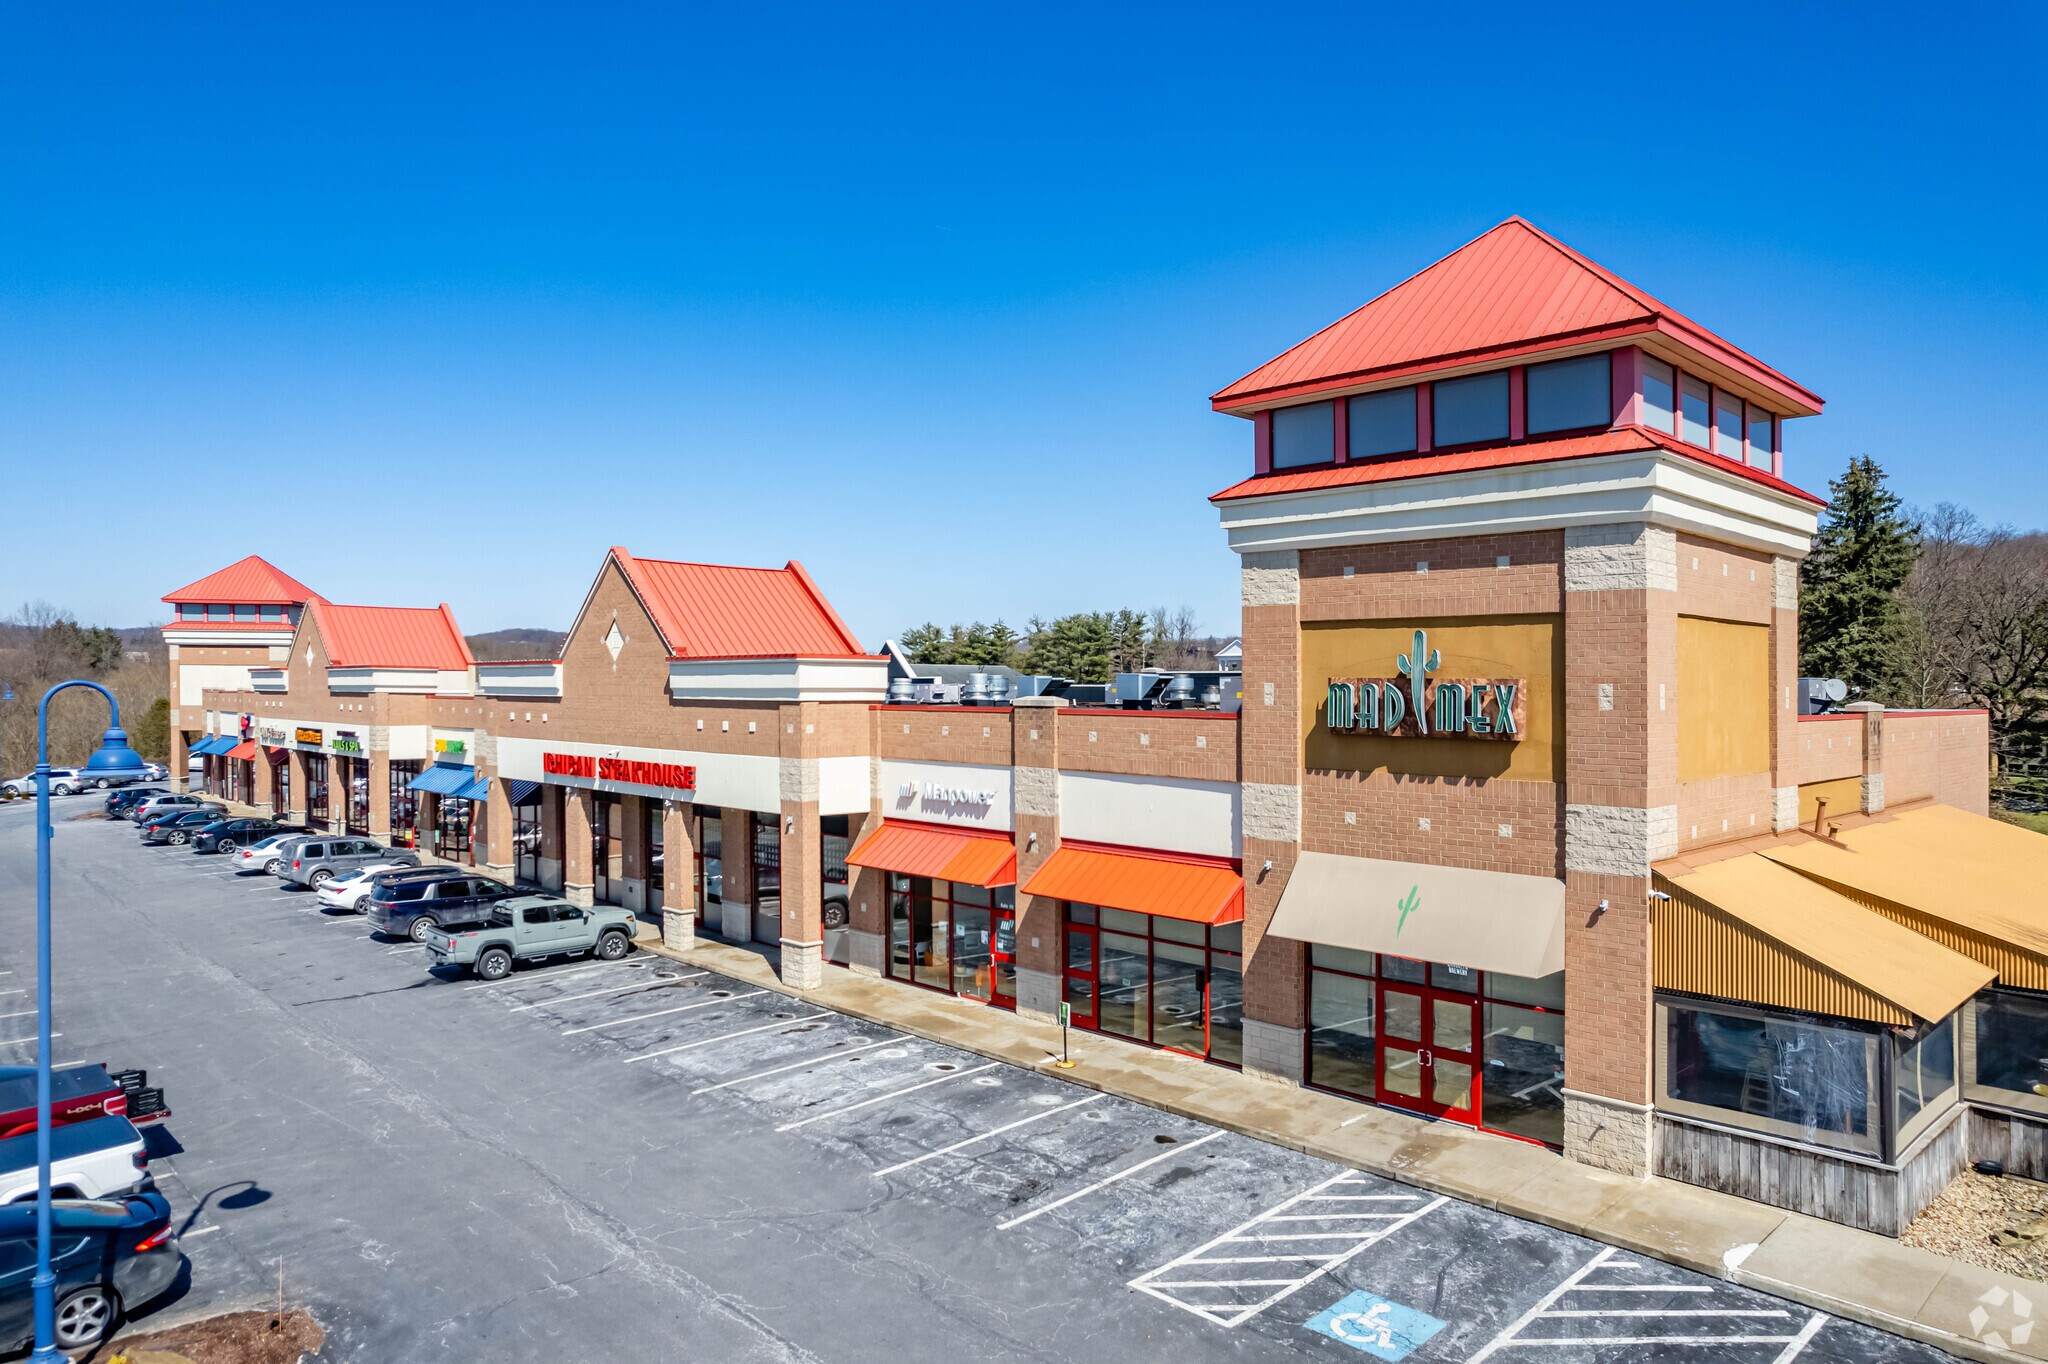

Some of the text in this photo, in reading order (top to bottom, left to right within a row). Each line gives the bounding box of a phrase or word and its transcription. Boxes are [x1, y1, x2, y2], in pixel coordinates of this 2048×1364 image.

[1327, 682, 1518, 734] MAD MEX
[598, 757, 697, 790] STEAKHOUSE
[922, 782, 995, 806] Manpower
